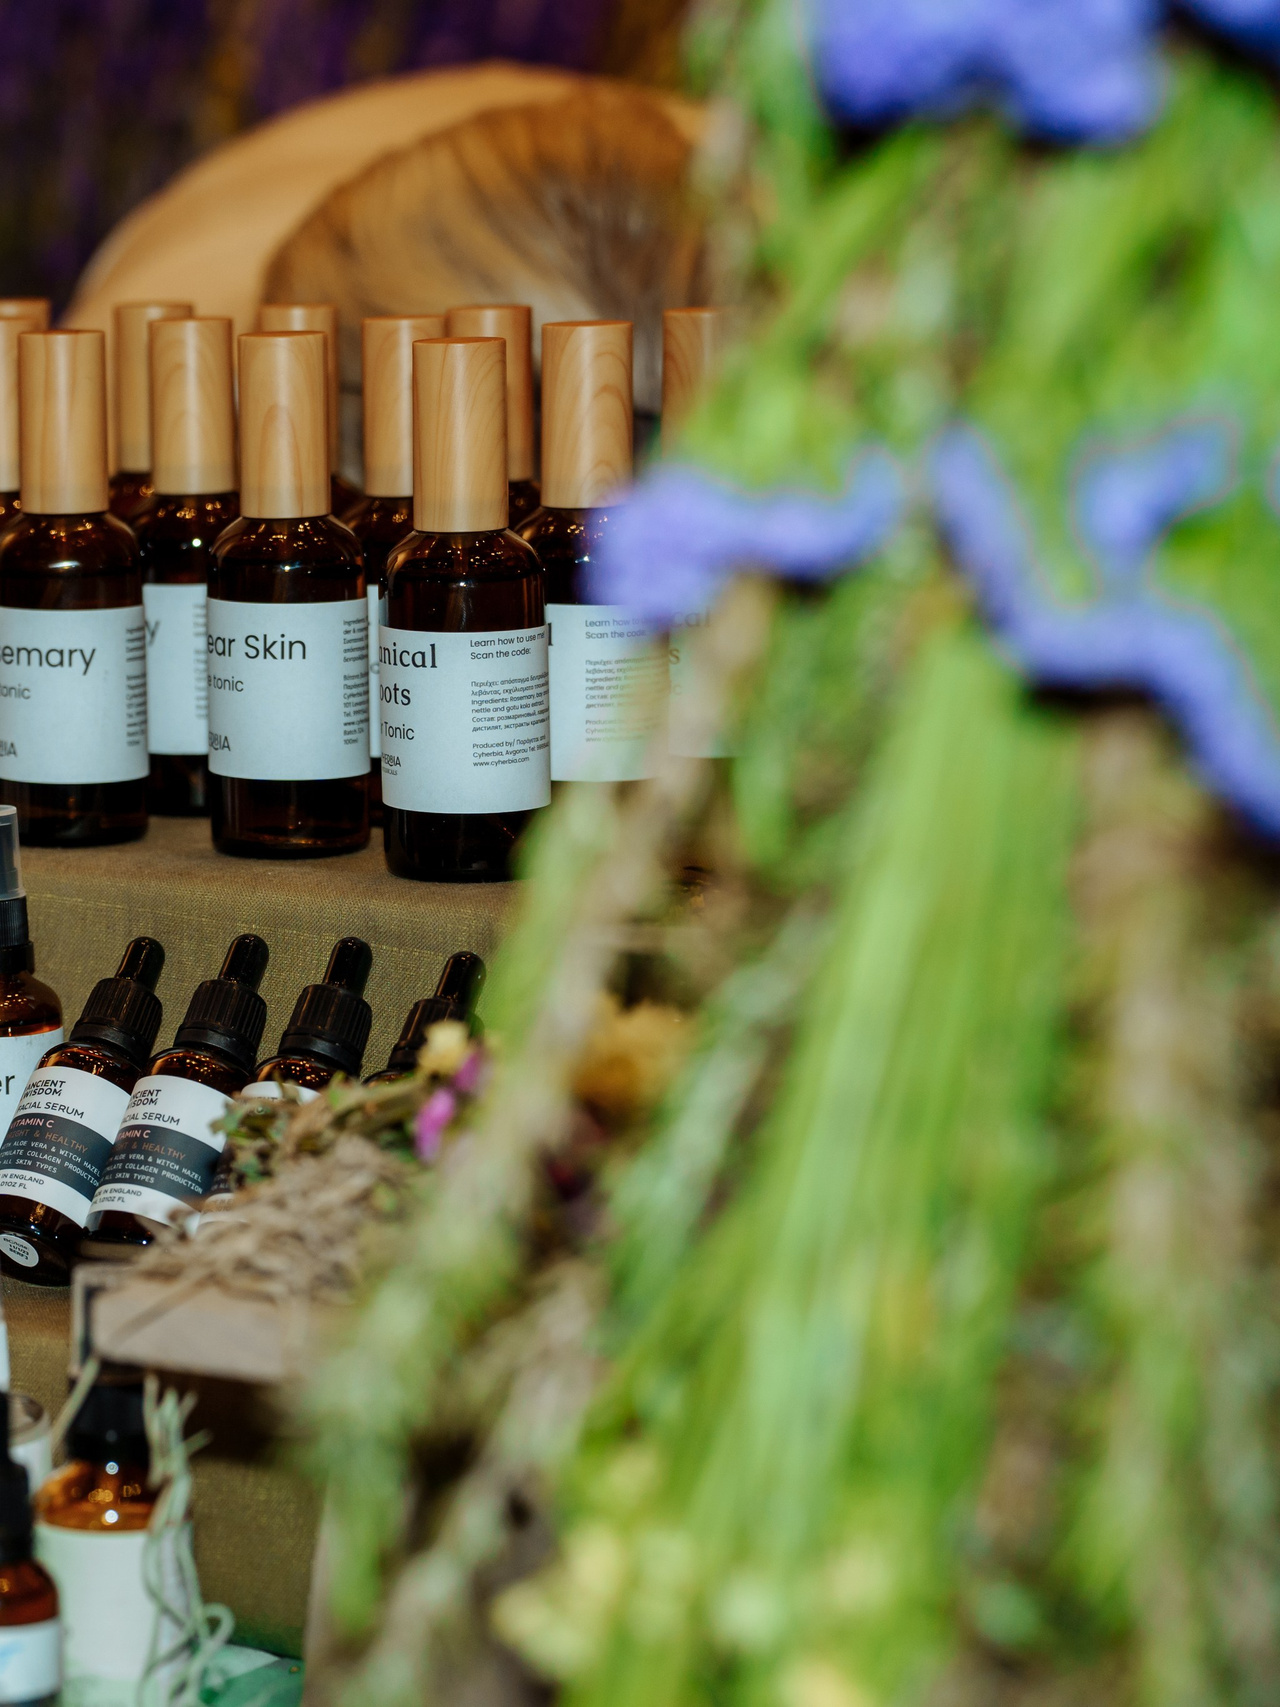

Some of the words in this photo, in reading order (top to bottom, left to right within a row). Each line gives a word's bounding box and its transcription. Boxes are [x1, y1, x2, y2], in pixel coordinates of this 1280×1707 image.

[585, 619, 610, 628] Learn
[585, 631, 608, 639] Scan
[611, 630, 625, 639] the
[244, 633, 306, 660] Skin
[470, 640, 496, 648] Learn
[498, 637, 515, 646] how
[516, 636, 524, 644] to
[470, 651, 494, 660] Scan
[496, 650, 510, 658] the
[213, 676, 244, 692] tonic
[472, 696, 508, 706] Ingredients:
[472, 706, 491, 714] nettle
[506, 705, 519, 713] gotu
[384, 721, 415, 741] Tonic
[472, 740, 504, 749] Produced
[473, 757, 530, 767] www.cyherbia.com
[26, 1079, 66, 1092] ANCIENT
[44, 1101, 84, 1119] SERUM
[10, 1118, 44, 1130] VITAMIN
[46, 1120, 55, 1128] C
[141, 1111, 181, 1126] SERUM
[143, 1130, 151, 1138] C
[45, 1131, 88, 1154] HEALTHY
[142, 1142, 186, 1161] HEALTHY
[31, 1141, 47, 1150] VERA
[60, 1148, 82, 1163] WITCH
[83, 1160, 101, 1177] HAZEL
[15, 1158, 33, 1166] SKIN
[35, 1161, 58, 1174] TYPES
[27, 1150, 61, 1165] COLLAGEN
[64, 1161, 100, 1187] PRODUCTION
[128, 1153, 145, 1161] VERA
[156, 1158, 180, 1171] WITCH
[181, 1167, 202, 1183] HAZEL
[9, 1173, 45, 1185] ENGLAND
[124, 1163, 159, 1174] COLLAGEN
[161, 1170, 203, 1195] PRODUCTION
[133, 1173, 155, 1184] TYPES
[109, 1188, 142, 1197] ENGLAND
